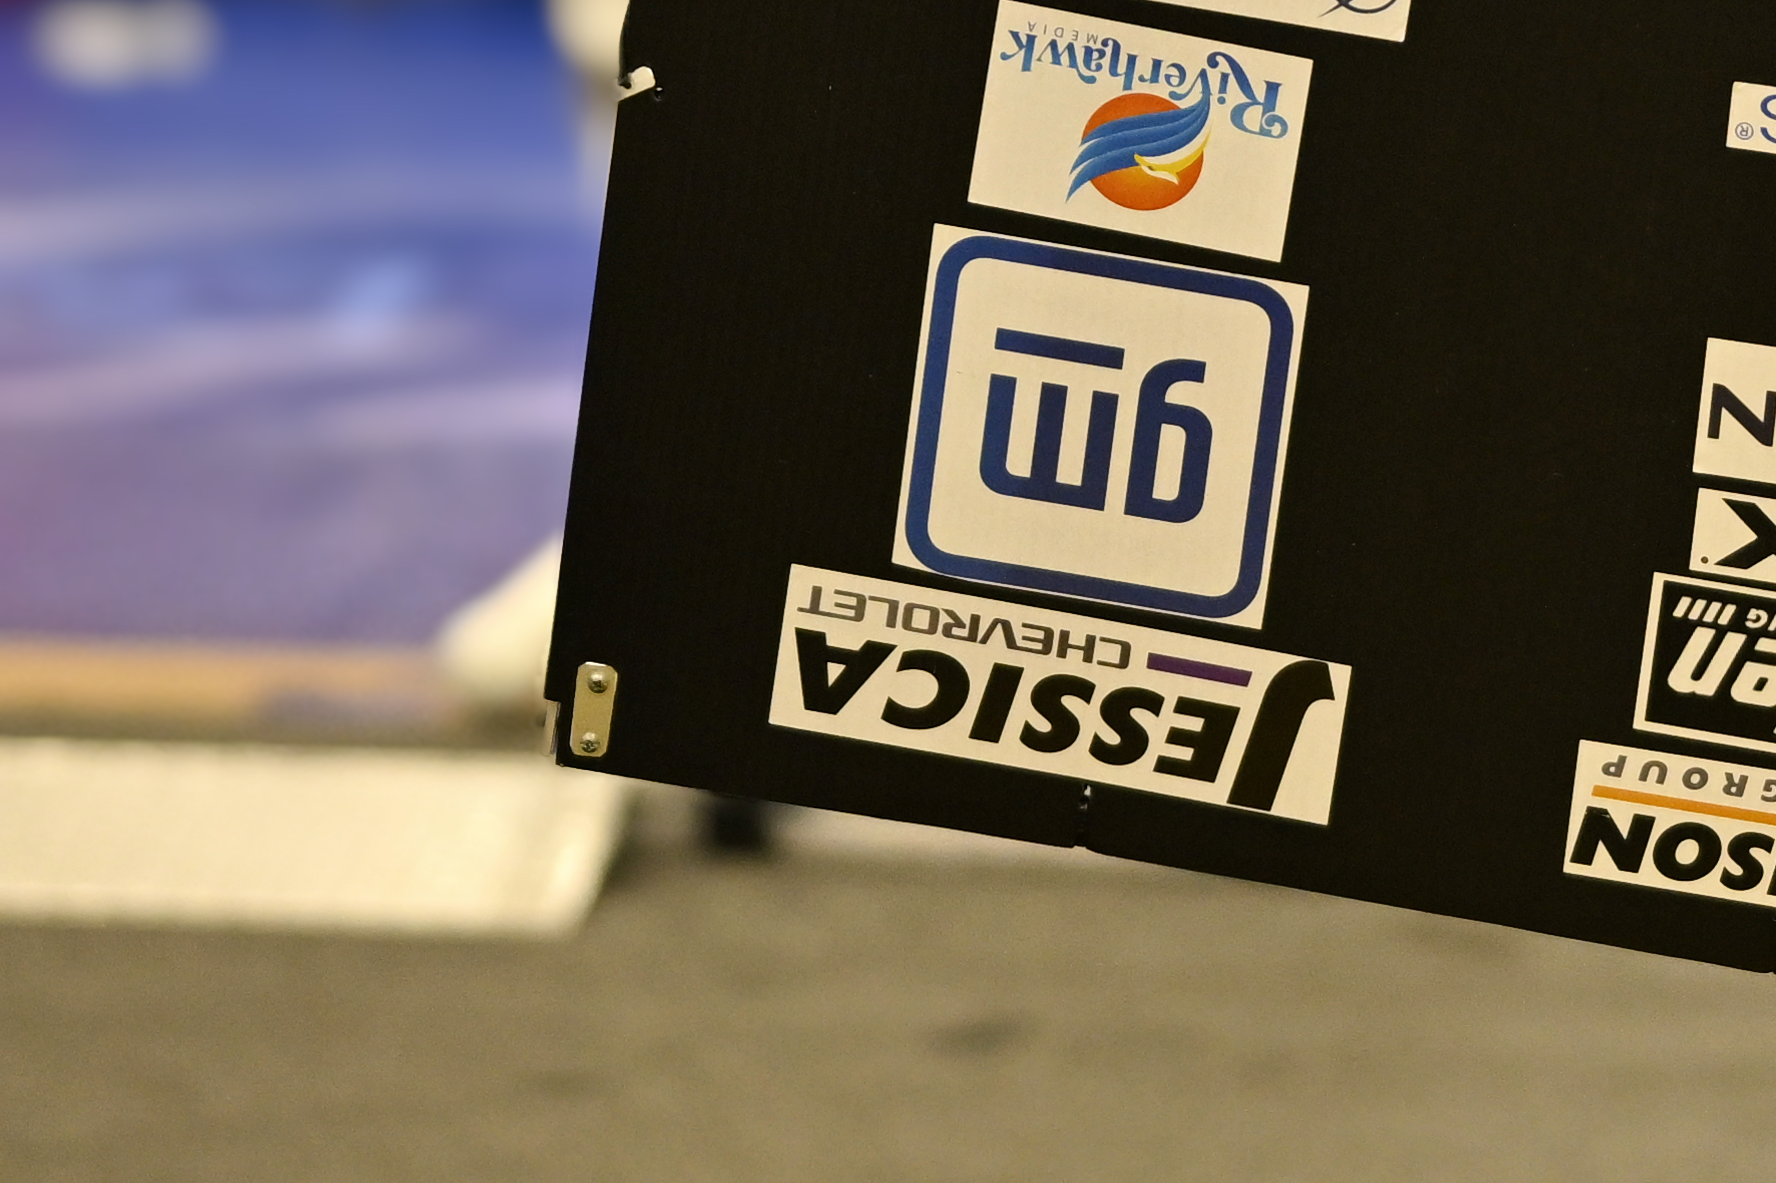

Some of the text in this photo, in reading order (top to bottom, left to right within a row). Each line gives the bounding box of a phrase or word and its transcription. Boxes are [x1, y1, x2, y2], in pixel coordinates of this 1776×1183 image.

[1000, 31, 1288, 139] Riverhawk
[1026, 21, 1098, 45] MEDIA
[979, 360, 1213, 524] gm
[797, 585, 1131, 670] CHEVROLET
[794, 627, 1335, 811] JESSICA
